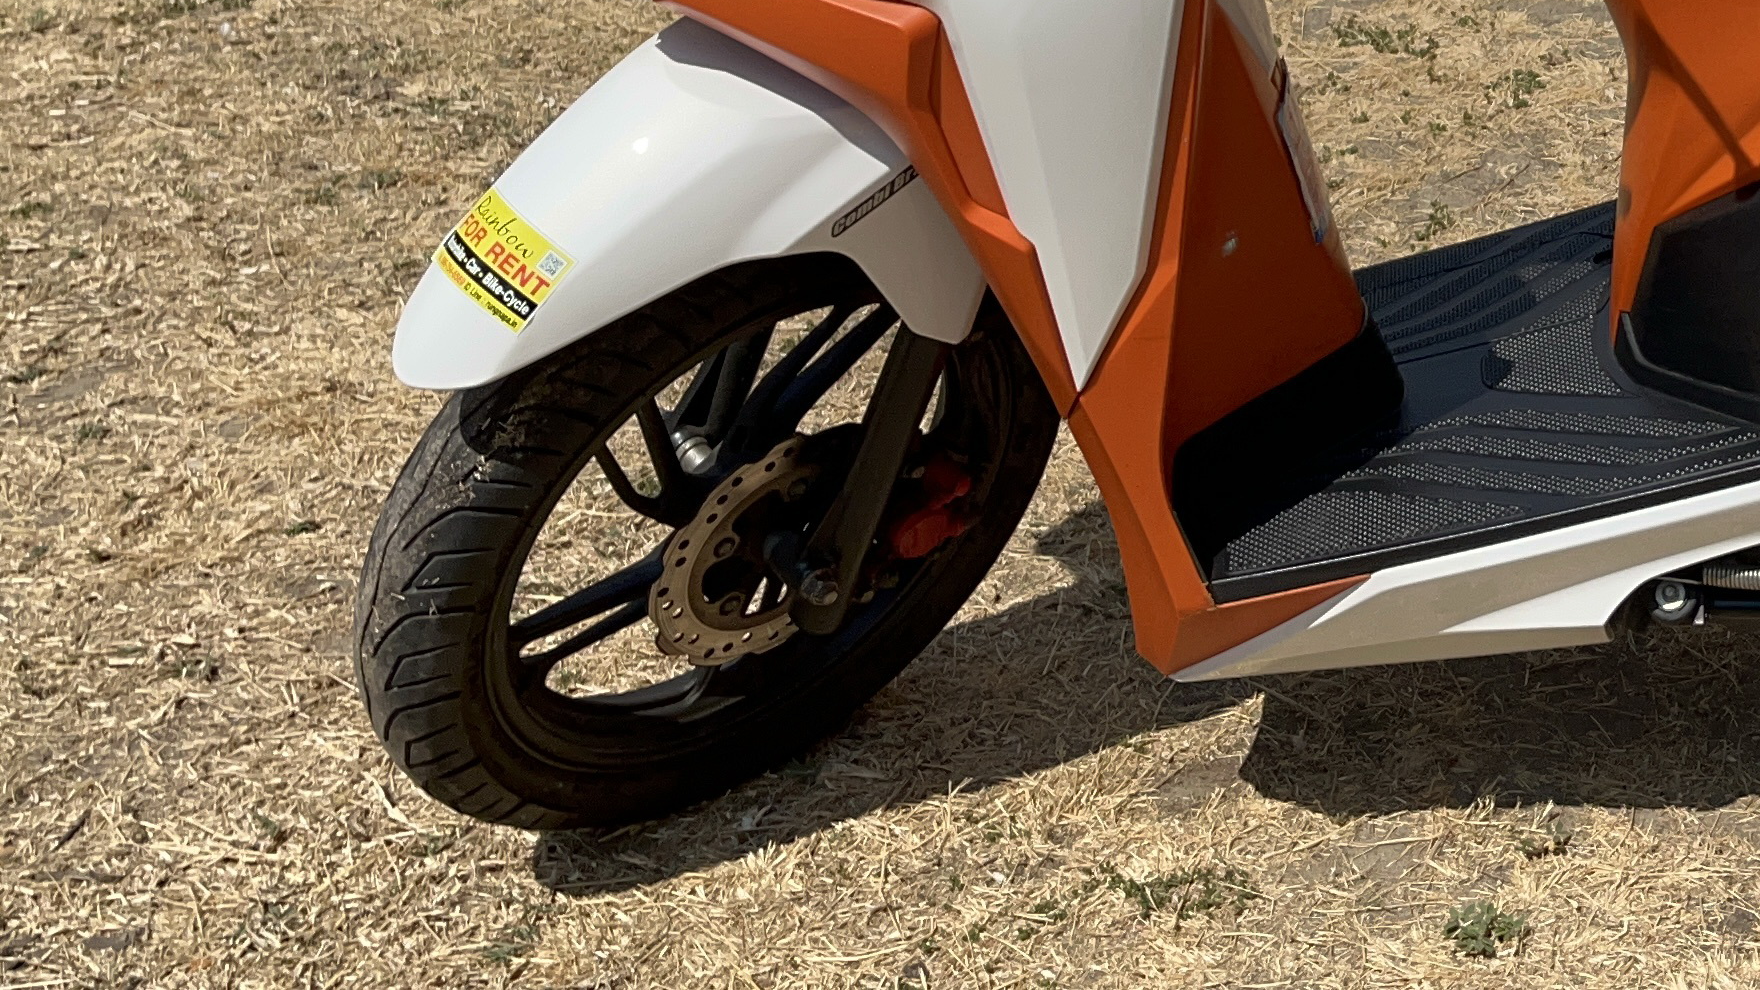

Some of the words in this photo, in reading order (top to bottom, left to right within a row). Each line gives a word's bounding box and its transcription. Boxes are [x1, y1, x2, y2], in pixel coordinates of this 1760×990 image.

[476, 195, 534, 259] Rainbow
[831, 181, 891, 238] Combi
[459, 213, 488, 249] FOR
[484, 240, 551, 296] RENT
[465, 257, 482, 275] Car
[482, 272, 530, 316] Bike-Cycle
